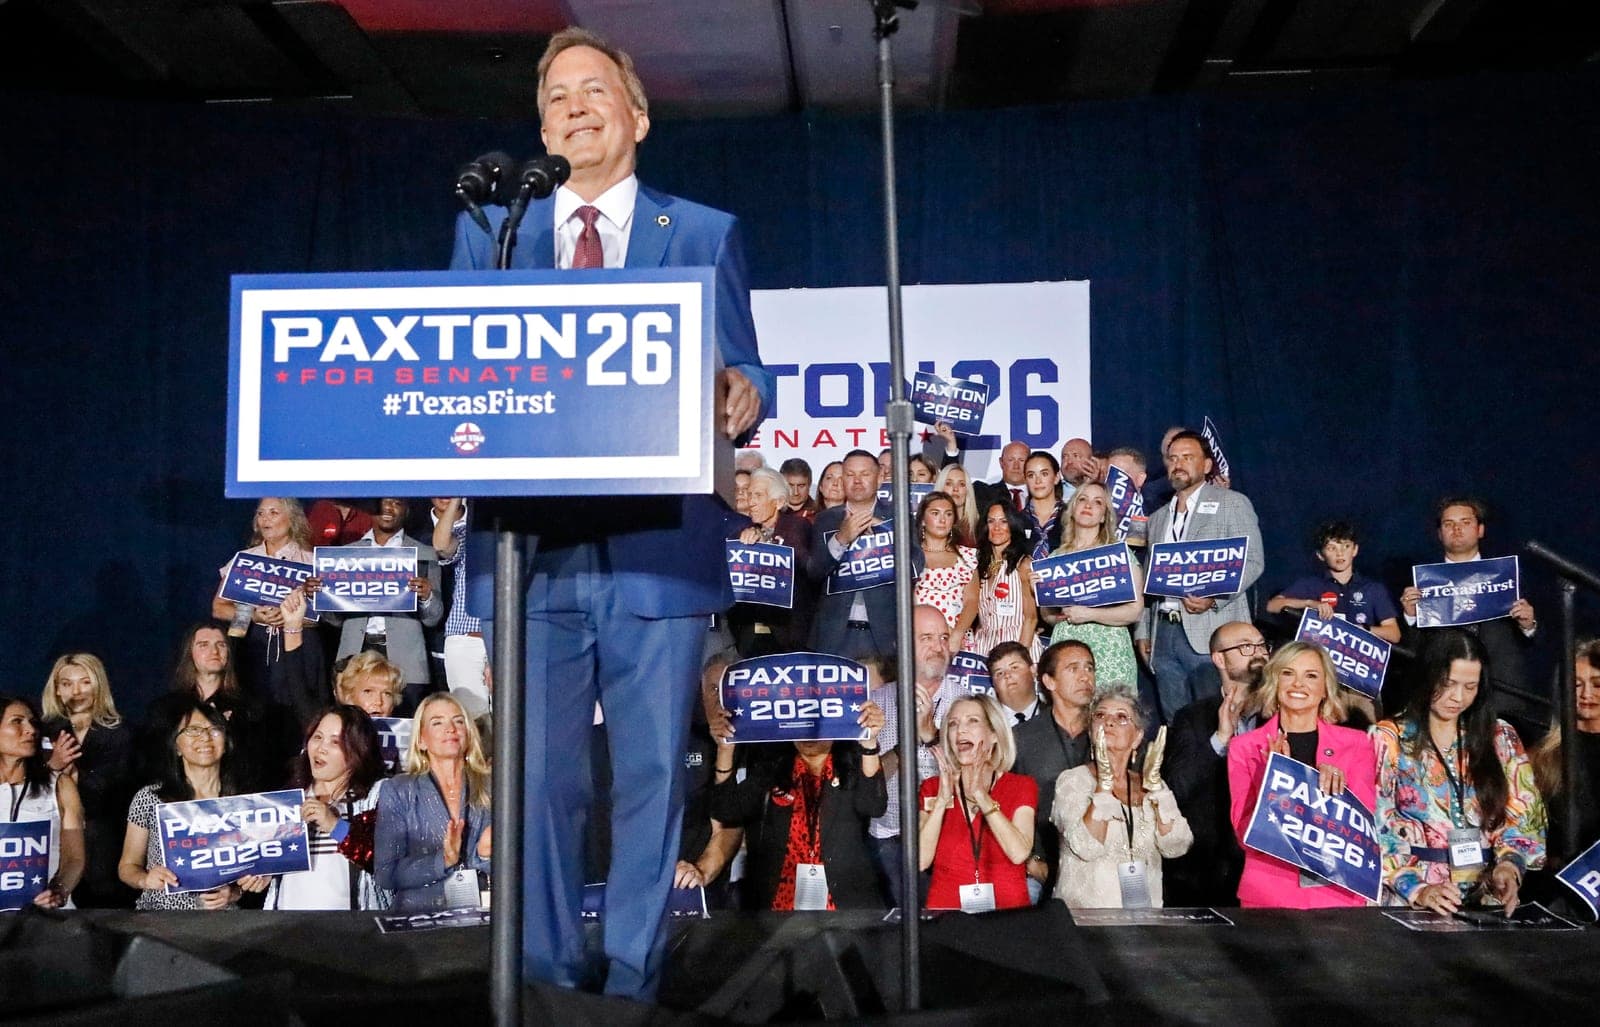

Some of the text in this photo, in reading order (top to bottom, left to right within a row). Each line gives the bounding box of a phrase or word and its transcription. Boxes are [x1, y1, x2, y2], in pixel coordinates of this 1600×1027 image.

[271, 311, 673, 386] PAXTON 26
[301, 366, 548, 385] FOR SENATE
[383, 388, 556, 415] #TexasFirst
[915, 380, 986, 404] PAXTON
[318, 557, 414, 572] PAXTON
[838, 555, 894, 577] 2026
[1036, 552, 1127, 582] PAXTON
[1155, 546, 1245, 565] PAXTON
[335, 581, 400, 596] 2026
[1055, 576, 1117, 598] 2026
[1166, 569, 1227, 587] 2026
[1421, 579, 1515, 598] #TexasFirst
[1305, 618, 1387, 663] PAXTON
[1324, 646, 1370, 678] 026
[728, 664, 864, 686] PAXTON
[727, 685, 864, 698] FOR SENATE
[750, 698, 844, 721] 2026
[1268, 792, 1305, 816] FOR
[1271, 769, 1378, 844] PAXTON
[164, 805, 301, 838] PAXTON
[168, 837, 209, 849] FOR
[1281, 814, 1365, 869] 2026
[191, 840, 283, 870] 2026
